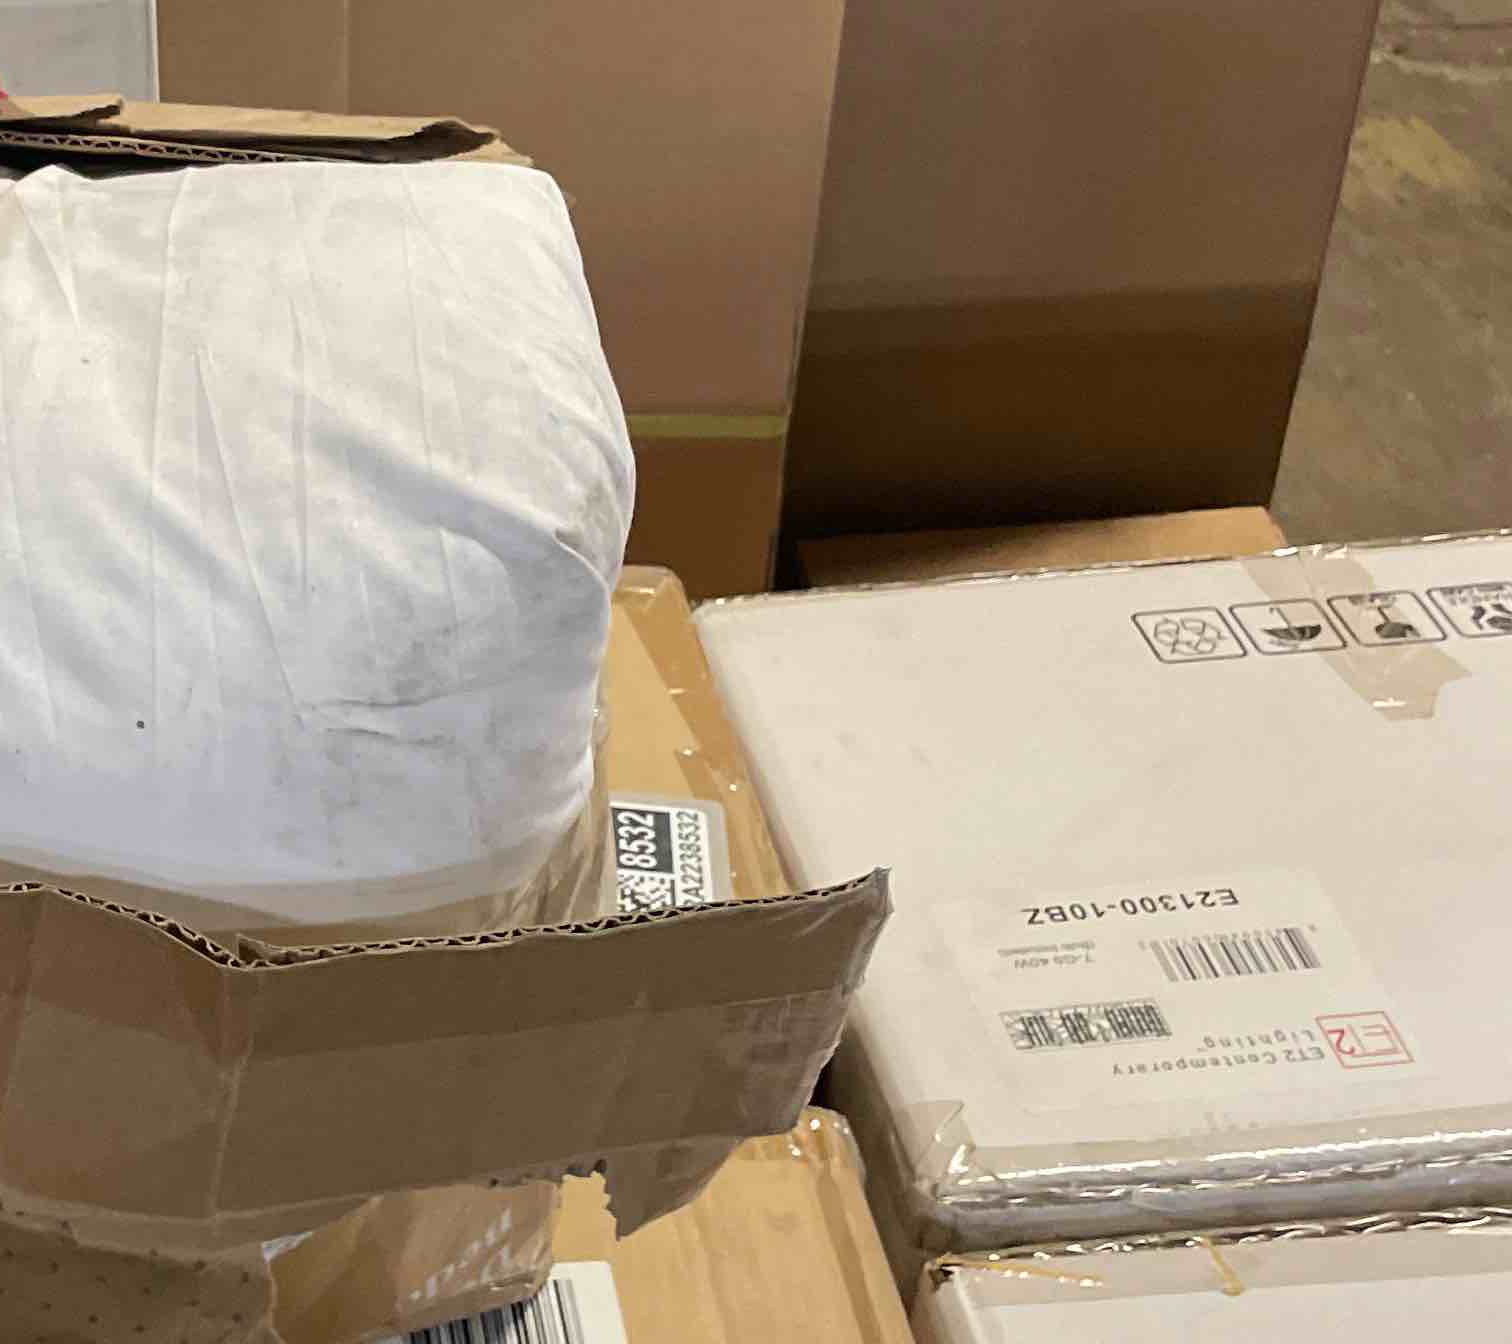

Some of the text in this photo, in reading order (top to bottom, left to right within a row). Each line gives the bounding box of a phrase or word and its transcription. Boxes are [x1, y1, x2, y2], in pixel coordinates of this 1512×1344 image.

[617, 812, 658, 868] 8532
[675, 810, 706, 908] A2238532
[1021, 886, 1240, 928] E21300-10BZ
[1111, 1052, 1278, 1077] Contemporary
